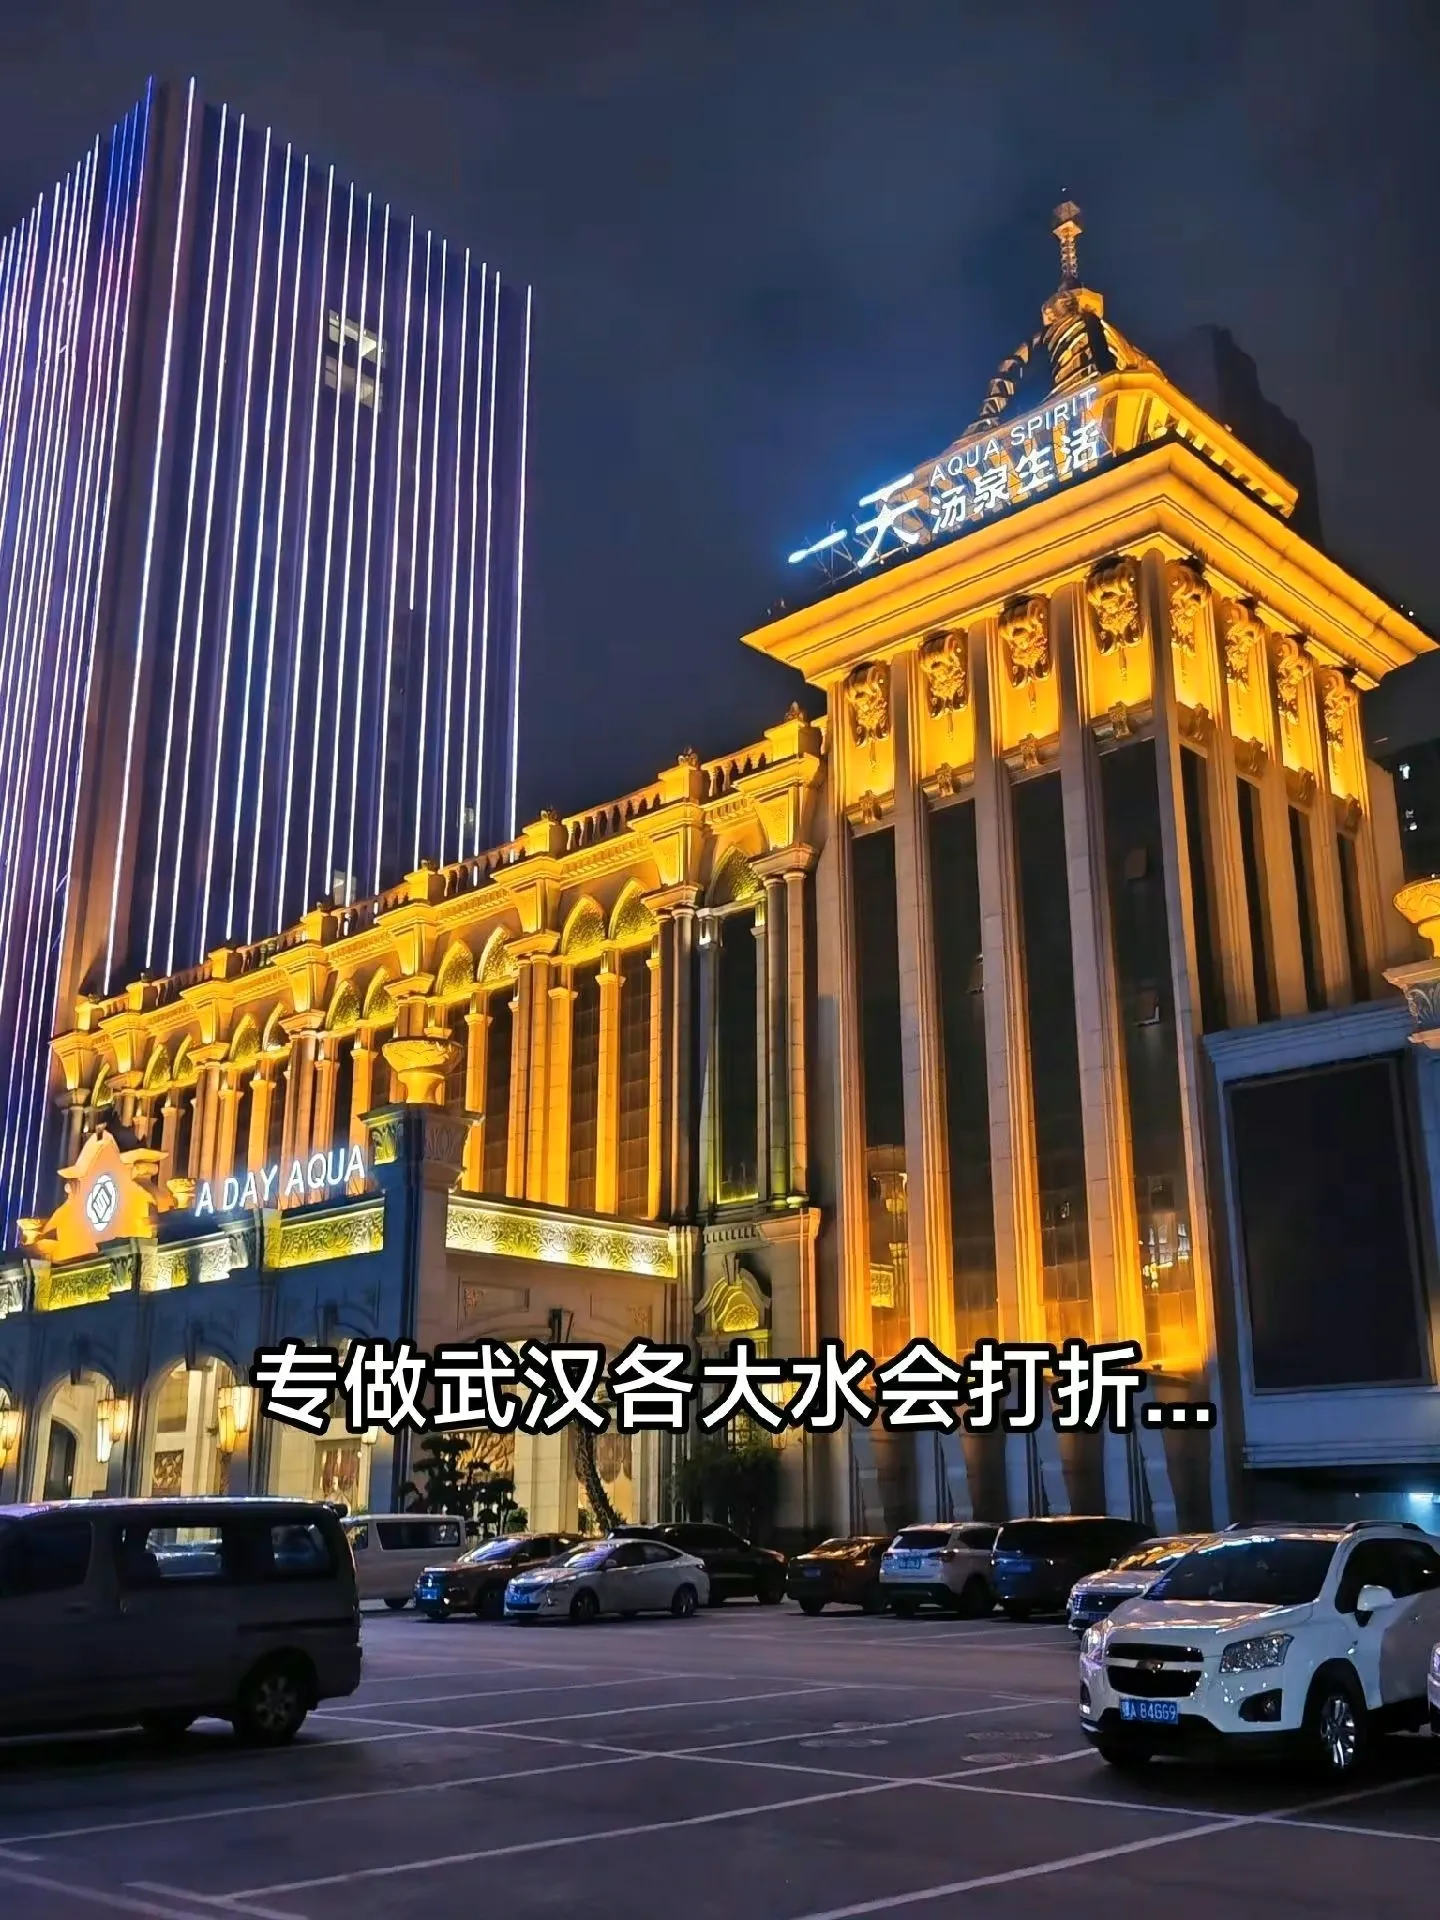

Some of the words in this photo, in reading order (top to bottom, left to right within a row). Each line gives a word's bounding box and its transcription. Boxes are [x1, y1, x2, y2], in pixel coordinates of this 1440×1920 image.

[930, 438, 1000, 487] AQUA
[1010, 386, 1097, 446] SPIRIT
[788, 473, 920, 568] 一天
[194, 1181, 215, 1218] A
[222, 1164, 278, 1212] DAY
[284, 1144, 366, 1197] AQUA
